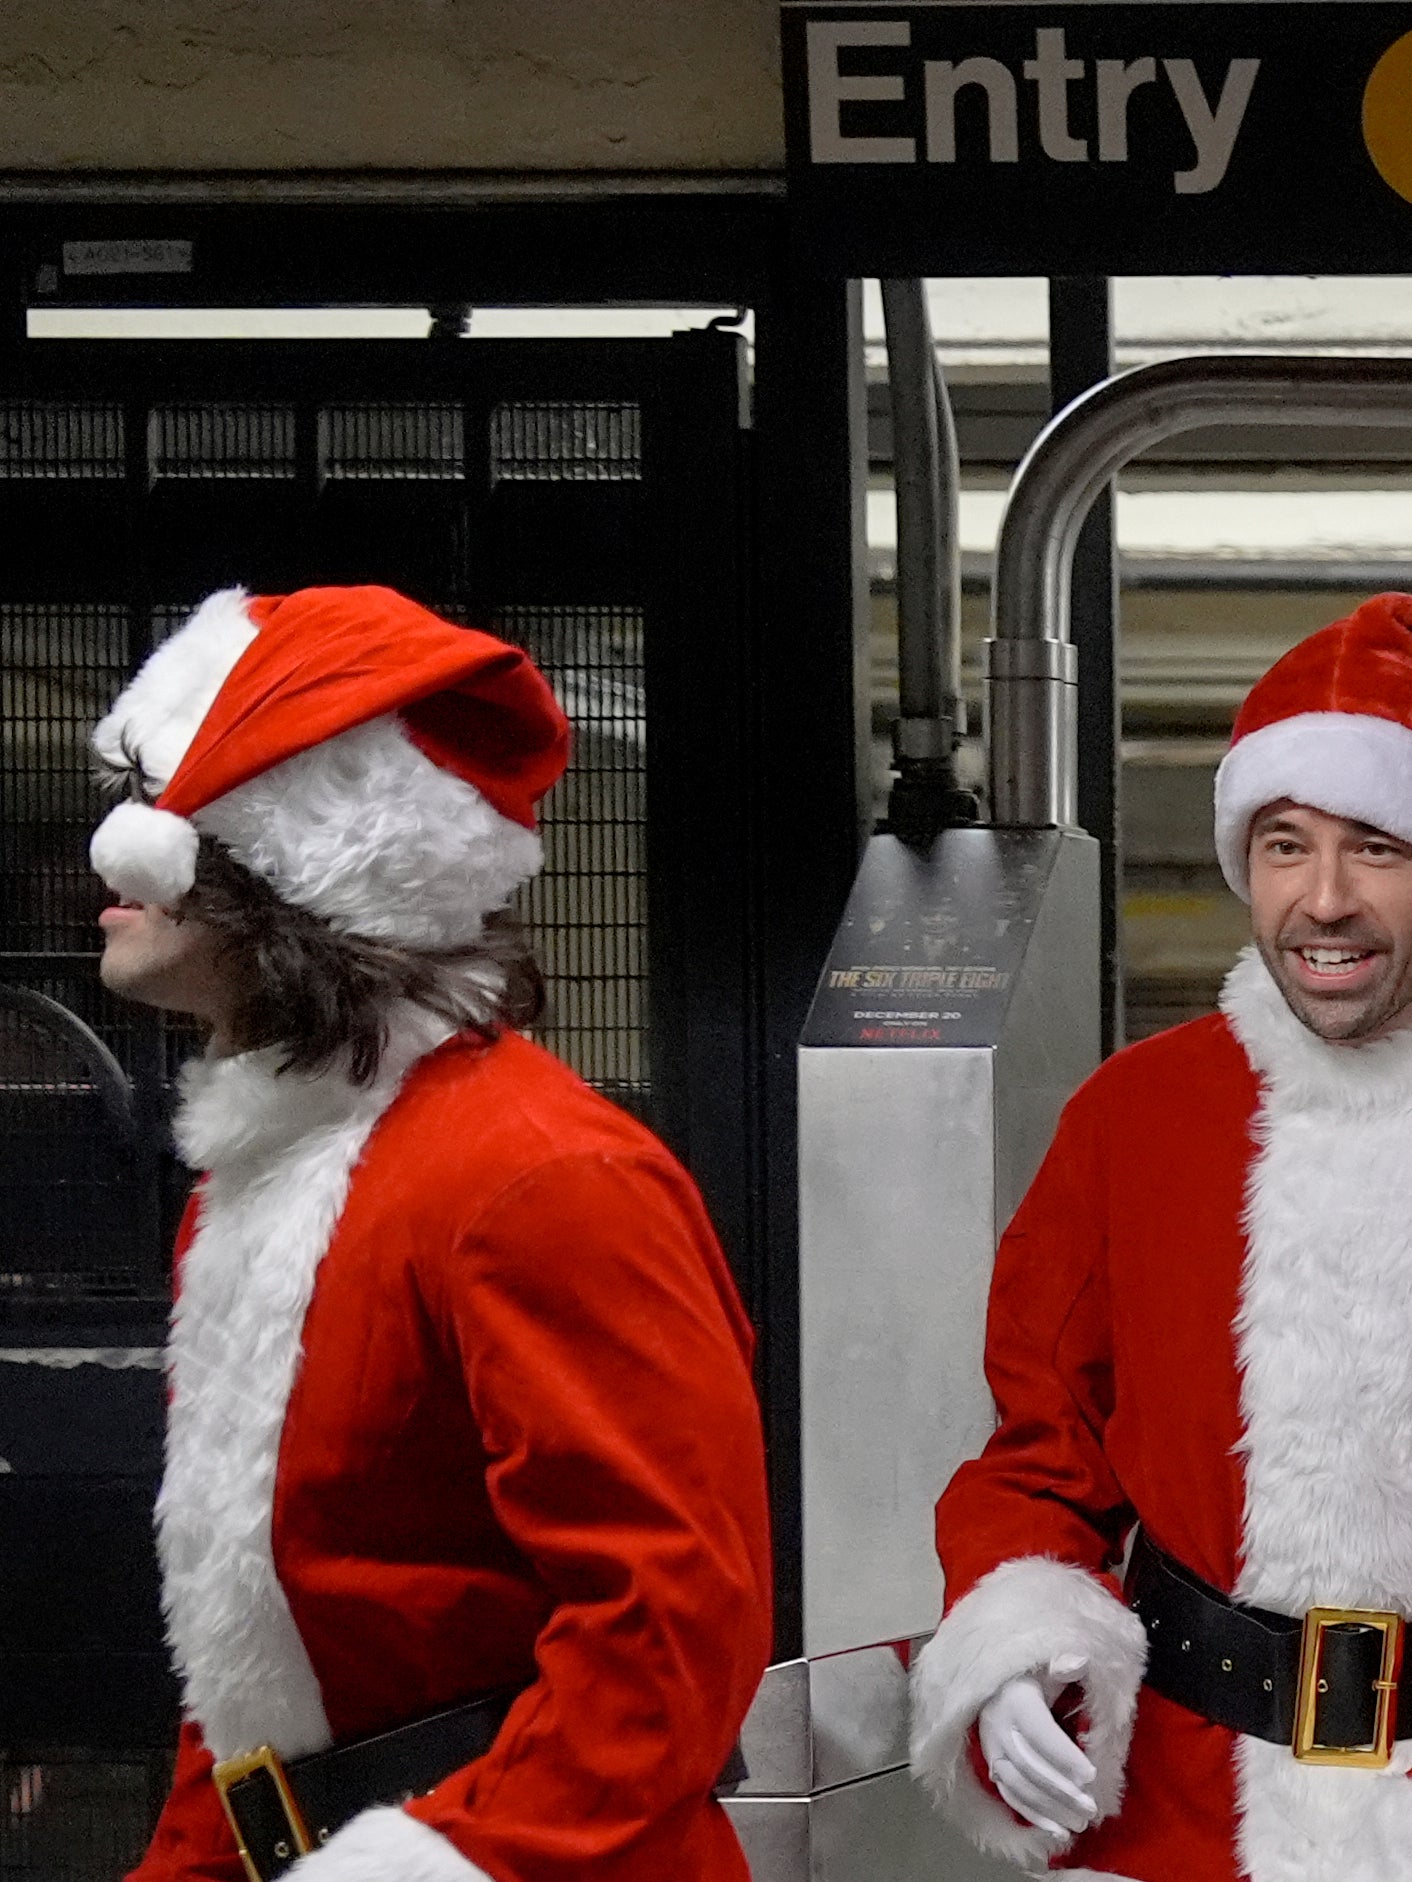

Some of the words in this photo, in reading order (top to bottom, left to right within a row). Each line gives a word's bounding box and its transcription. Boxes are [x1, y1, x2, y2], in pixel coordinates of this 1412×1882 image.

[806, 19, 1261, 195] Entry
[829, 971, 859, 989] THE
[862, 971, 896, 989] SIX
[900, 972, 957, 989] TRIPLE
[853, 1011, 939, 1020] DECEMBER
[941, 1011, 963, 1020] 20
[859, 1028, 941, 1040] NETFLIX
